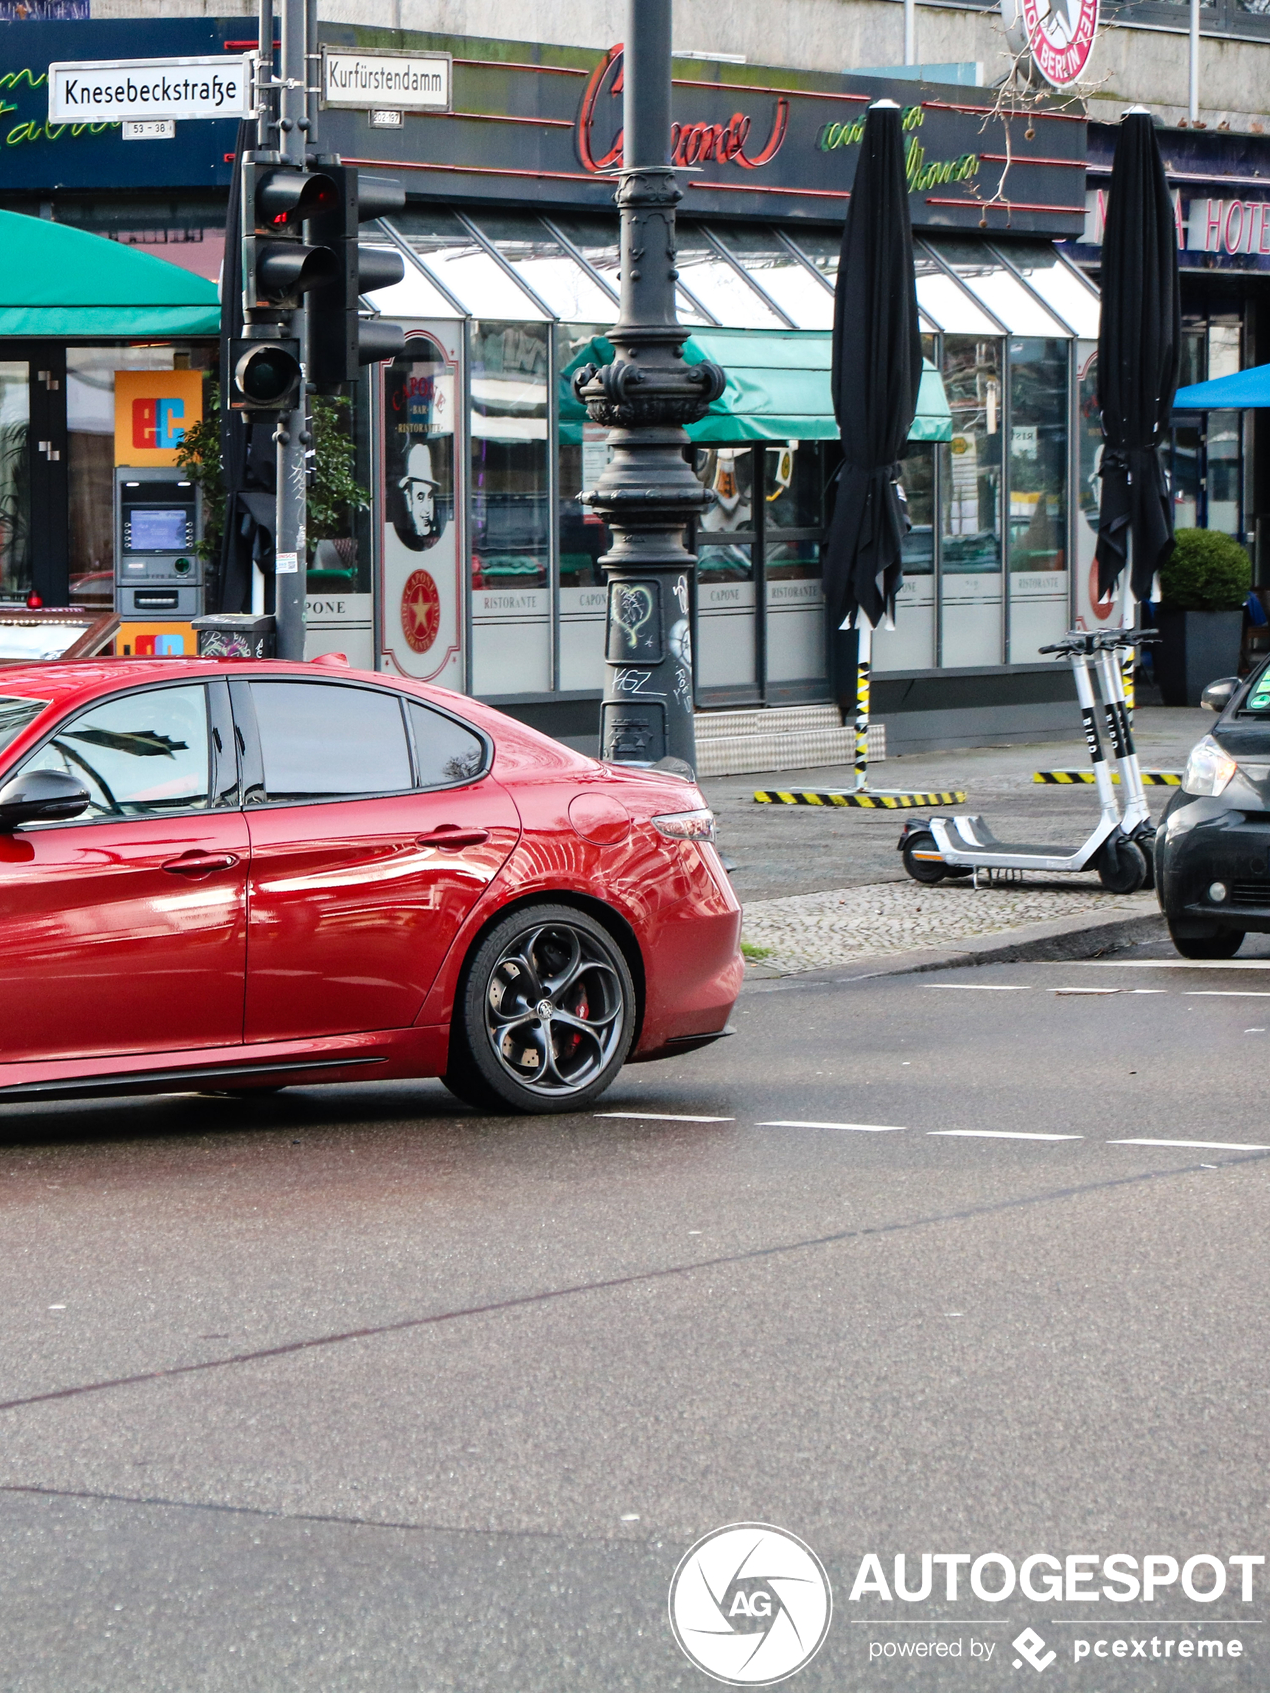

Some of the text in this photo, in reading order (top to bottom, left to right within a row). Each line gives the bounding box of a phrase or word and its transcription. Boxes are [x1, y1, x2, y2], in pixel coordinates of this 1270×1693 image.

[1040, 42, 1082, 79] BERLIN
[329, 61, 442, 92] Kurfürstendamm
[65, 75, 237, 107] Knesebeckstraße
[133, 124, 144, 133] 53
[154, 123, 166, 133] 38
[392, 377, 446, 414] CAPONE
[411, 405, 429, 414] BAR
[397, 424, 441, 433] RISTORANTE
[1019, 577, 1058, 589] RISTORANTE
[710, 589, 739, 601] CAPONE
[772, 586, 817, 599] RISTORANTE
[484, 596, 537, 609] RISTORANTE
[580, 594, 606, 606] CAPON
[306, 602, 346, 614] PONE
[1083, 716, 1098, 753] BIRD
[1106, 713, 1119, 749] BIRD
